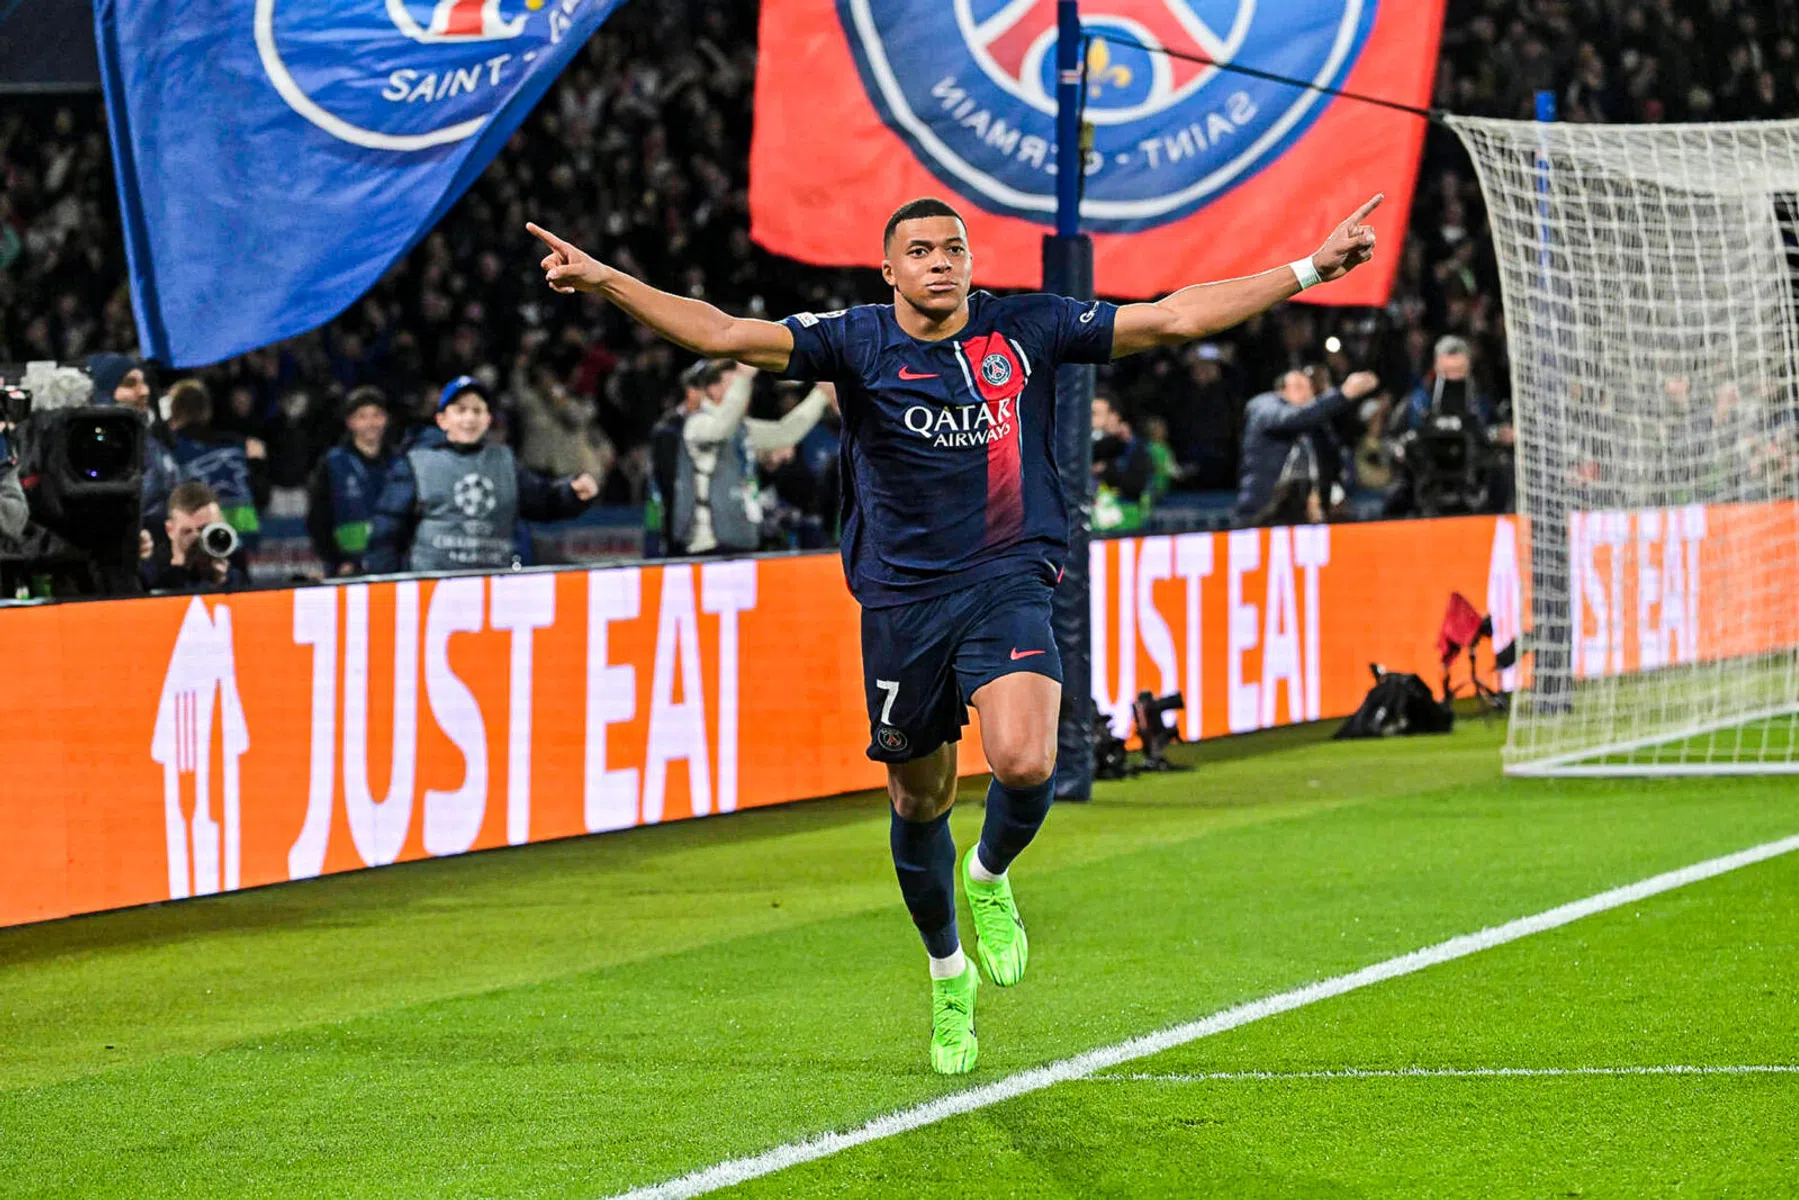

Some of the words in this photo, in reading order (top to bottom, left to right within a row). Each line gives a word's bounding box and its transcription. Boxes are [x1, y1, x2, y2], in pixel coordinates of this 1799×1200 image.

[382, 53, 511, 103] SAINT
[904, 398, 1011, 438] QATAR
[933, 421, 1011, 447] AIRWAYS
[1637, 502, 1706, 673] EAT
[1089, 531, 1213, 742] UST
[1227, 523, 1330, 735] EAT
[287, 573, 555, 880] JUST
[584, 559, 757, 833] EAT
[876, 678, 900, 726] 7
